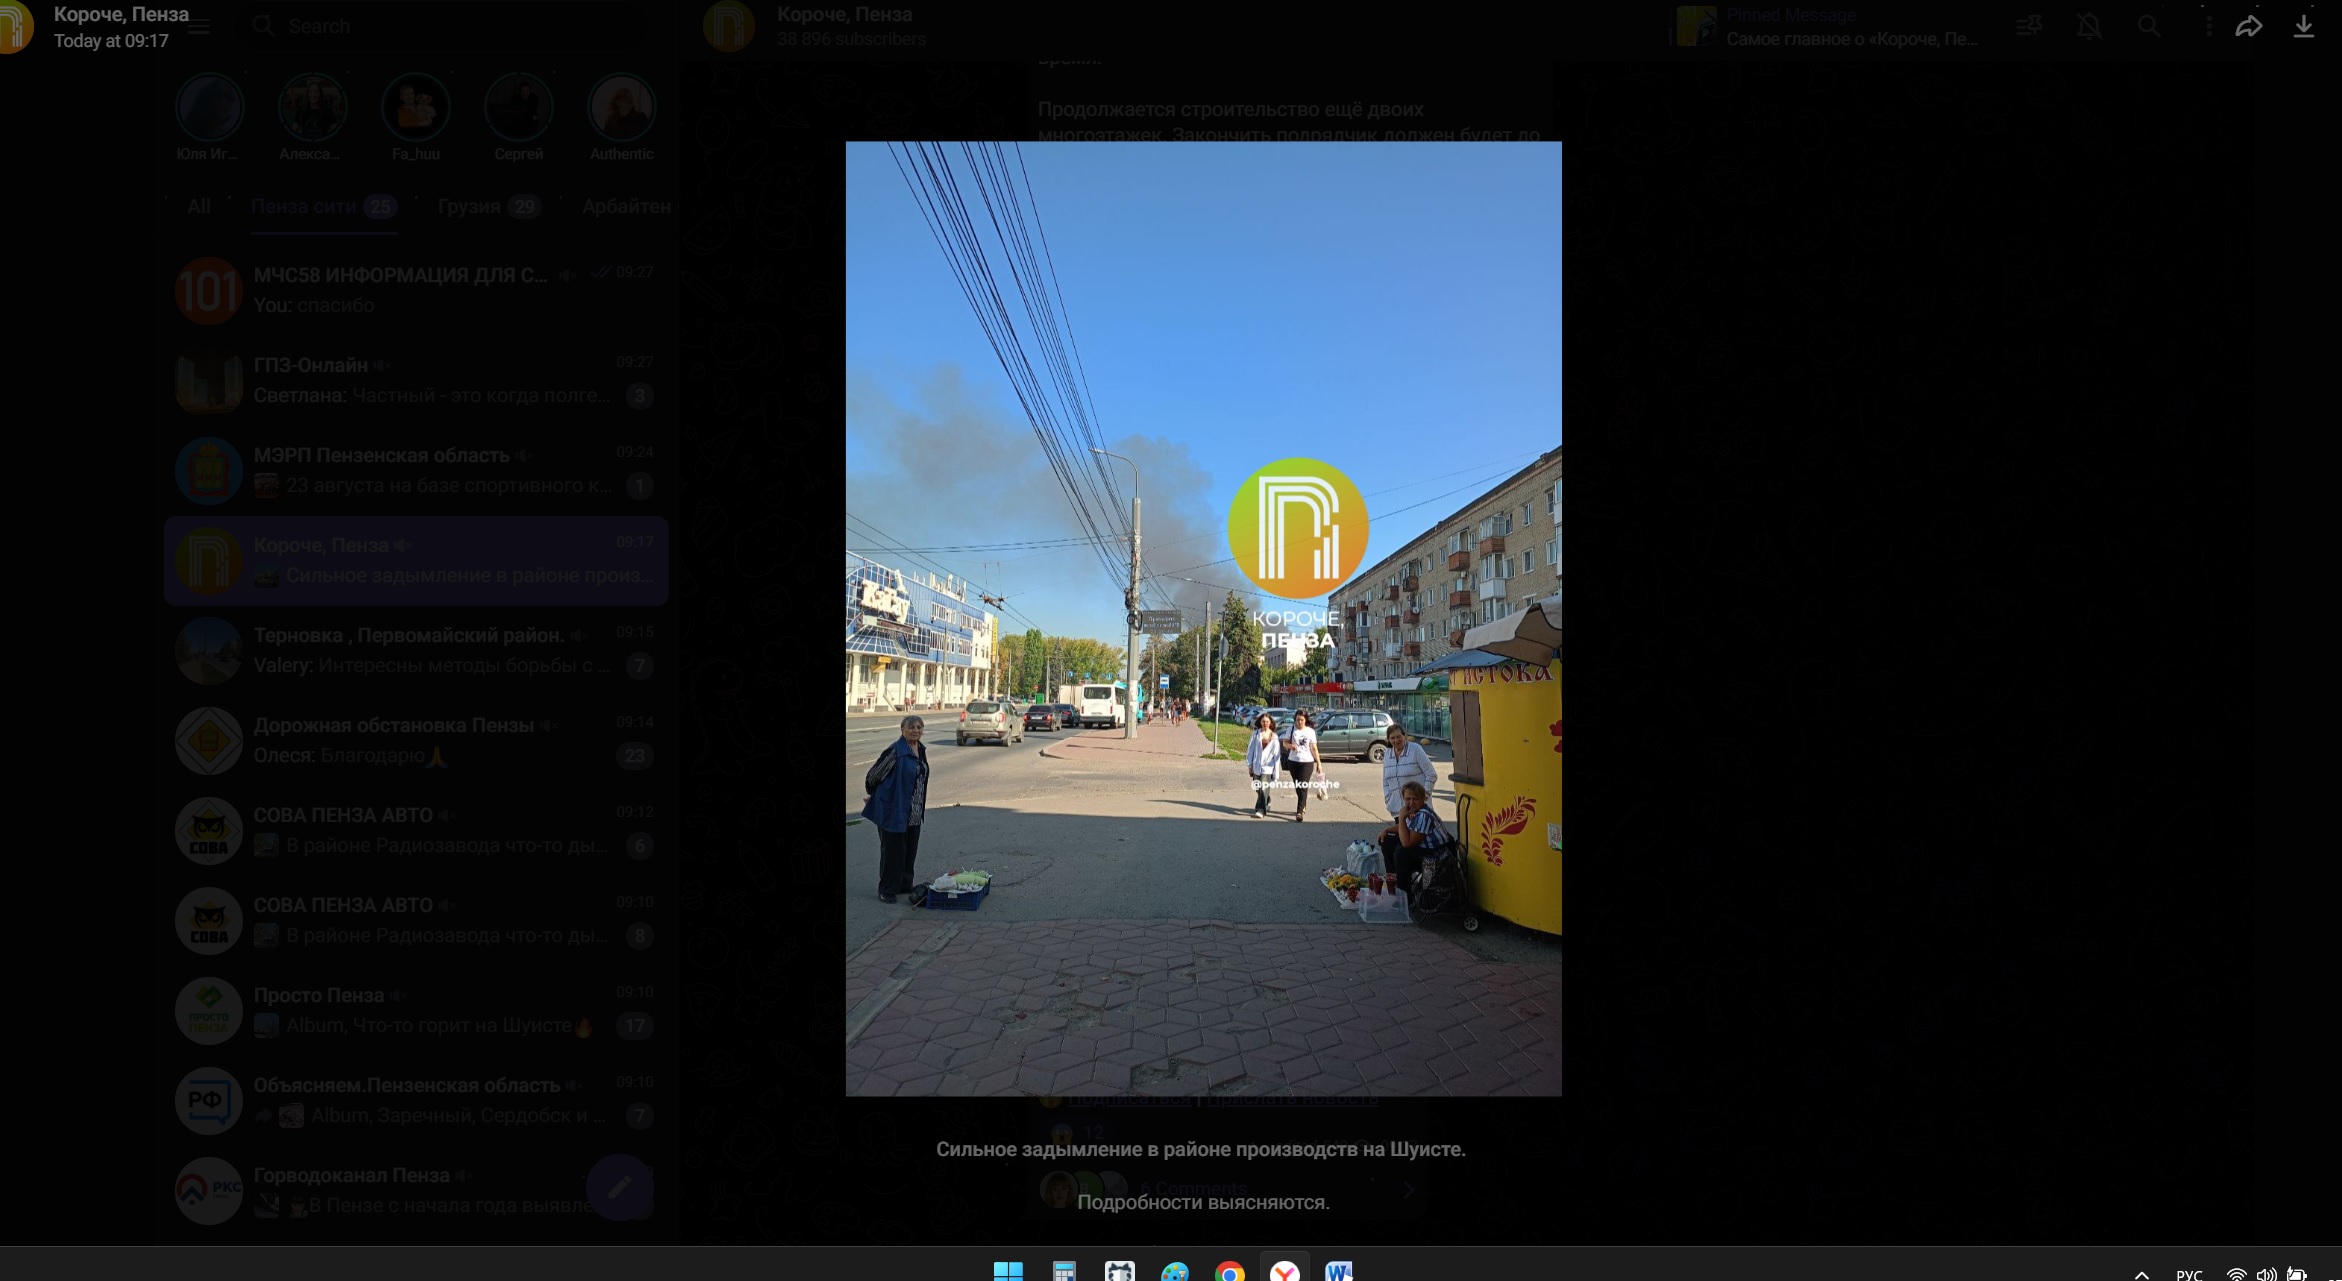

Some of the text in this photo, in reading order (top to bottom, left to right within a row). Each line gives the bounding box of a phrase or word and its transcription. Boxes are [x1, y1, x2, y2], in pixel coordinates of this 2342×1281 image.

[55, 6, 189, 25] Короче, Пенза
[778, 6, 912, 25] Короче, Пенза
[1728, 8, 1856, 25] Pinned Message
[290, 18, 349, 33] Search
[54, 33, 169, 51] Today at 09:17
[778, 31, 926, 46] 38 896 subscribers
[1039, 101, 1424, 120] Продолжается строительство ещё двоих
[393, 148, 440, 160] Fa_huu
[495, 148, 543, 162] Сергей
[590, 147, 654, 159] Authentic
[188, 198, 210, 213] All
[252, 198, 356, 214] Пенза сити
[371, 199, 391, 213] 25
[439, 199, 500, 217] Грузия
[512, 200, 535, 215] 29
[583, 198, 671, 217] Арбайтен
[617, 266, 654, 277] 09:27
[254, 297, 374, 312] You: спасибо
[255, 358, 368, 373] ГПЗ-Онлайн
[617, 356, 653, 367] 09:27
[254, 387, 346, 403] Светлана:
[354, 387, 434, 402] Частный
[452, 391, 481, 402] это
[488, 391, 538, 405] когда
[255, 446, 510, 463] МЭРП Пензенская область
[617, 446, 654, 457] 09:24
[287, 477, 308, 492] 23
[315, 481, 384, 496] августа
[391, 481, 411, 492] на
[417, 477, 459, 492] базе
[465, 481, 583, 496] спортивного
[254, 538, 389, 555] Короче, Пенза
[617, 536, 654, 547] 09:17
[287, 567, 368, 582] Сильное
[373, 571, 490, 585] задымление
[496, 571, 507, 582] в
[513, 567, 579, 586] районе
[254, 627, 564, 646] Терновка Первомайский район.
[617, 626, 654, 637] 09:15
[254, 657, 592, 677] Valery: Интересны методы борьбы с
[254, 716, 534, 736] Дорожная обстановка Пензы
[617, 716, 654, 727] 09:14
[254, 747, 425, 766] Олеся: Благодарю
[625, 749, 645, 764] 23
[254, 807, 433, 822] СОВА ПЕНЗА АВТО
[617, 806, 654, 817] 09:12
[288, 838, 298, 852] В
[305, 837, 371, 856] районе
[377, 838, 499, 855] Радиозавода
[506, 841, 563, 852] что-то
[254, 897, 433, 912] СОВА ПЕНЗА АВТО
[617, 896, 653, 907] 09:10
[288, 928, 298, 942] В
[305, 927, 371, 946] районе
[377, 928, 499, 945] Радиозавода
[506, 931, 563, 942] что-то
[255, 987, 384, 1006] Просто Пенза
[617, 986, 653, 997] 09:10
[286, 1017, 572, 1036] Album, Что-то горит на Шуисте
[626, 1019, 645, 1032] 17
[254, 1076, 560, 1093] Объясняем.Пензенская область
[617, 1076, 653, 1087] 09:10
[312, 1107, 587, 1126] Album, Заречный, Сердобск и
[937, 1141, 1017, 1156] Сильное
[1023, 1145, 1142, 1159] задымление
[1149, 1145, 1158, 1156] в
[1165, 1141, 1231, 1160] районе
[1237, 1145, 1357, 1160] производств
[1364, 1145, 1384, 1156] на
[1392, 1142, 1465, 1160] Шуисте.
[255, 1167, 450, 1186] Горводоканал Пенза
[310, 1198, 320, 1212] В
[328, 1197, 383, 1212] Пензе
[389, 1201, 398, 1212] с
[405, 1201, 469, 1212] начала
[476, 1201, 516, 1215] года
[1079, 1194, 1329, 1213] Подробности выясняются.
